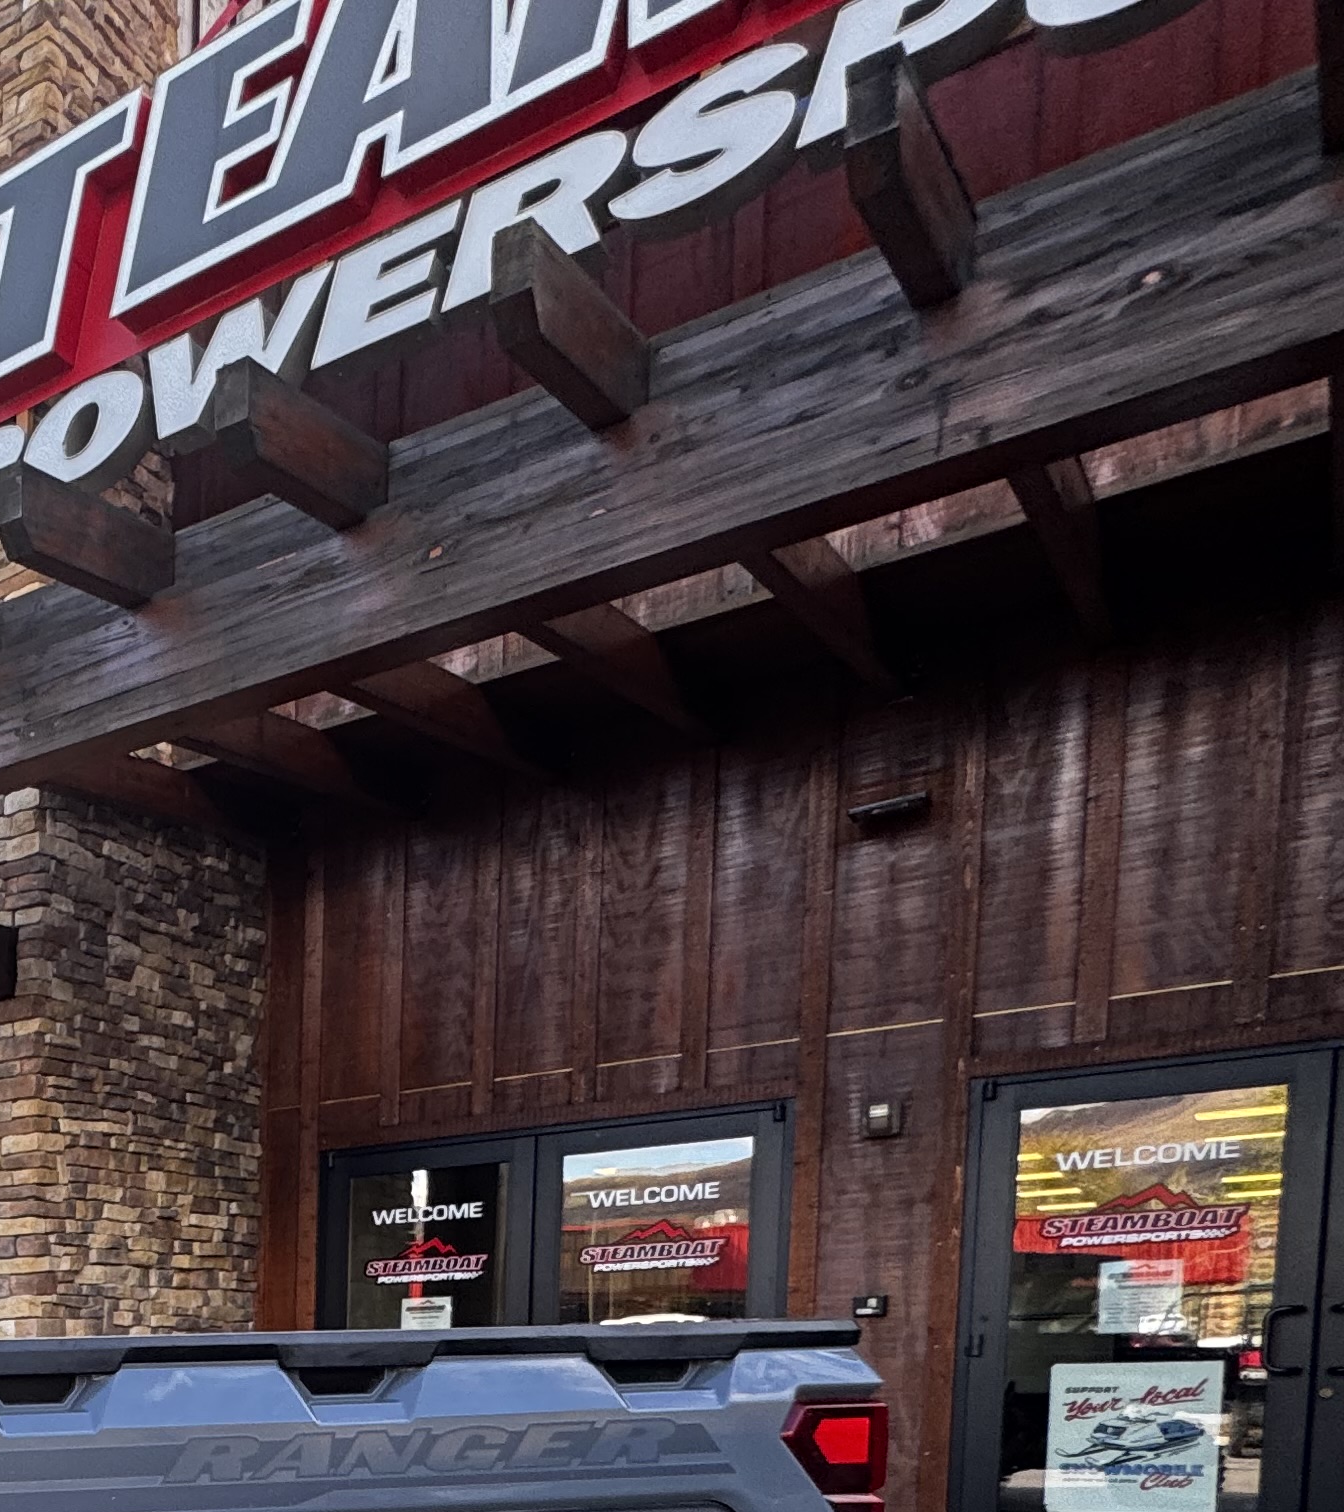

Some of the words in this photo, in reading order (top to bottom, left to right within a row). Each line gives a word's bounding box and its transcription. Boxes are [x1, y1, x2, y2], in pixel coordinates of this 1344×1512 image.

[1055, 1140, 1242, 1171] WELCOME
[588, 1181, 721, 1209] WELCOME
[372, 1201, 483, 1226] WELCOME
[1041, 1205, 1248, 1238] STEAMBOAT
[580, 1238, 729, 1264] STEAMBOAT
[1060, 1229, 1206, 1248] POWERSPORTS
[365, 1254, 489, 1277] STEAMBOAT
[1064, 1386, 1119, 1394] SUPPORT
[1062, 1397, 1124, 1422] Your
[163, 1417, 679, 1484] RANGER
